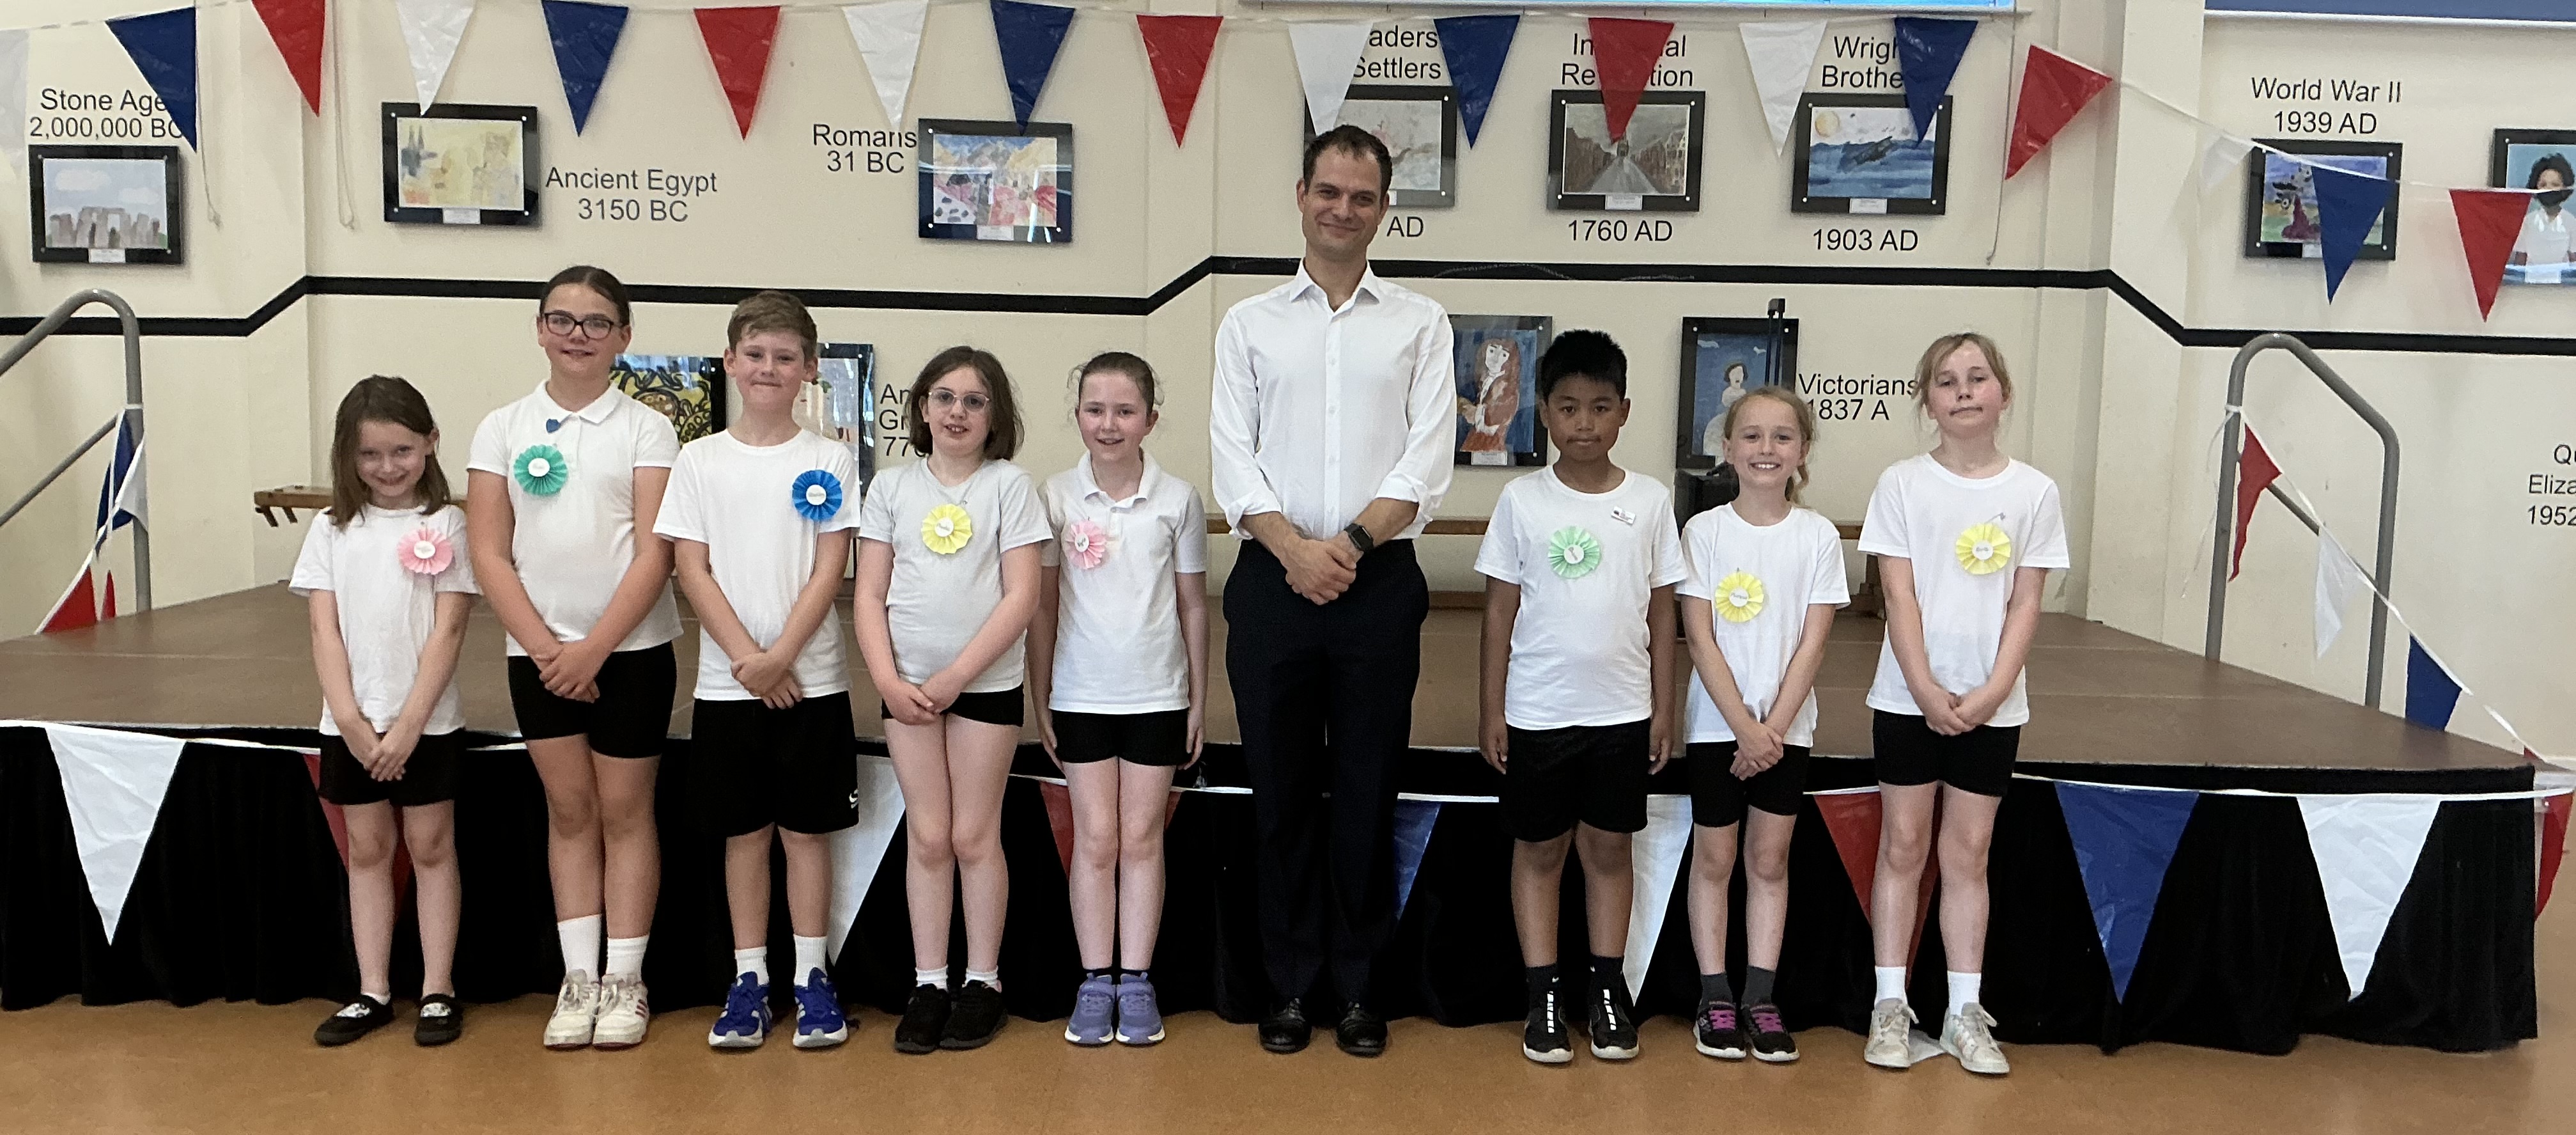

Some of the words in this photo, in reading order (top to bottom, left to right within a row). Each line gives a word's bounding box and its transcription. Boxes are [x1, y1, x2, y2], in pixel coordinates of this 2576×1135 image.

[1369, 25, 1438, 48] aders
[1353, 56, 1442, 79] Settlers
[1562, 63, 1693, 87] Retion
[1822, 65, 1904, 88] Brothe
[2251, 77, 2322, 100] World
[2331, 79, 2381, 102] War
[2387, 81, 2402, 103] II
[40, 88, 113, 111] Stone
[120, 89, 167, 116] Age
[29, 116, 143, 139] 2,000,000
[2274, 111, 2332, 134] 1939
[2338, 112, 2377, 134] AD
[813, 123, 918, 148] Romans
[827, 150, 854, 172] 31
[867, 151, 904, 173] BC
[545, 166, 639, 189] Ancient
[648, 169, 718, 197] Egypt
[578, 198, 640, 221] 3150
[650, 200, 688, 222] BC
[1386, 215, 1424, 237] AD
[1568, 219, 1628, 242] 1760
[1634, 219, 1673, 242] AD
[1813, 228, 1873, 251] 1903
[1879, 229, 1919, 251] AD
[1798, 373, 1920, 396] Victorians
